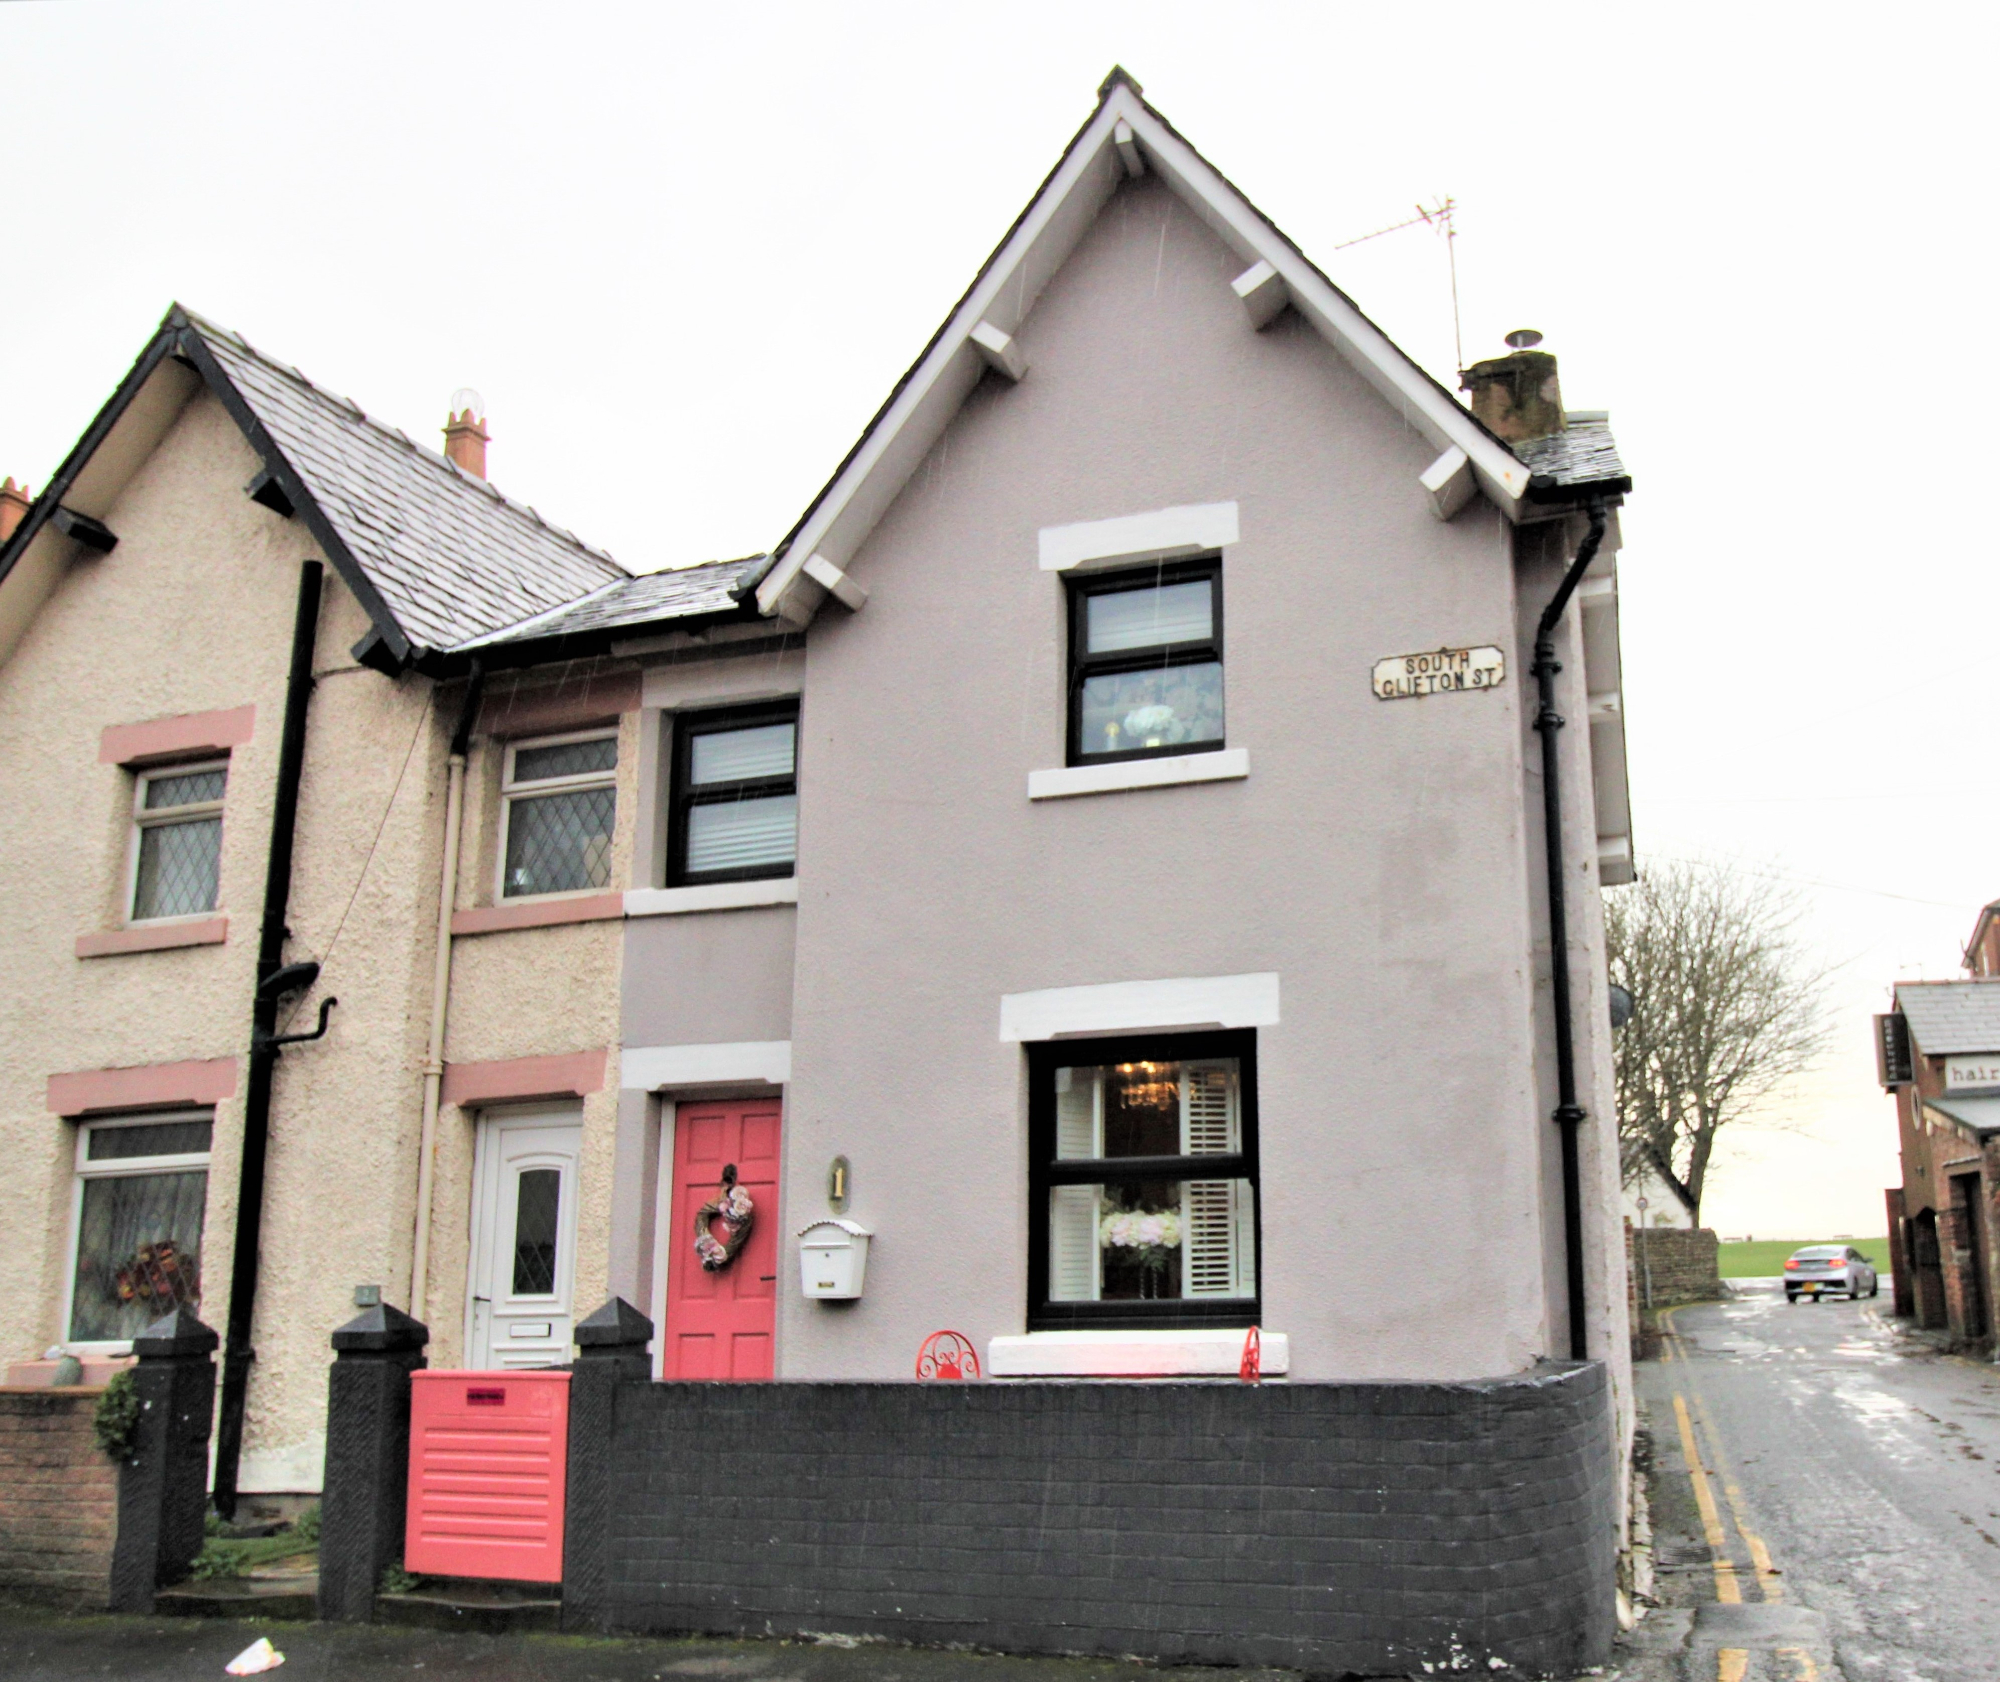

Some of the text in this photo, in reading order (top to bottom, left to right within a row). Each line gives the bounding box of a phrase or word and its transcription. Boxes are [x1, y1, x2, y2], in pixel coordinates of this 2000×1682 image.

[1405, 651, 1470, 675] SOUTH
[1472, 667, 1496, 685] ST
[1951, 1066, 2000, 1081] hair
[834, 1167, 844, 1198] 1
